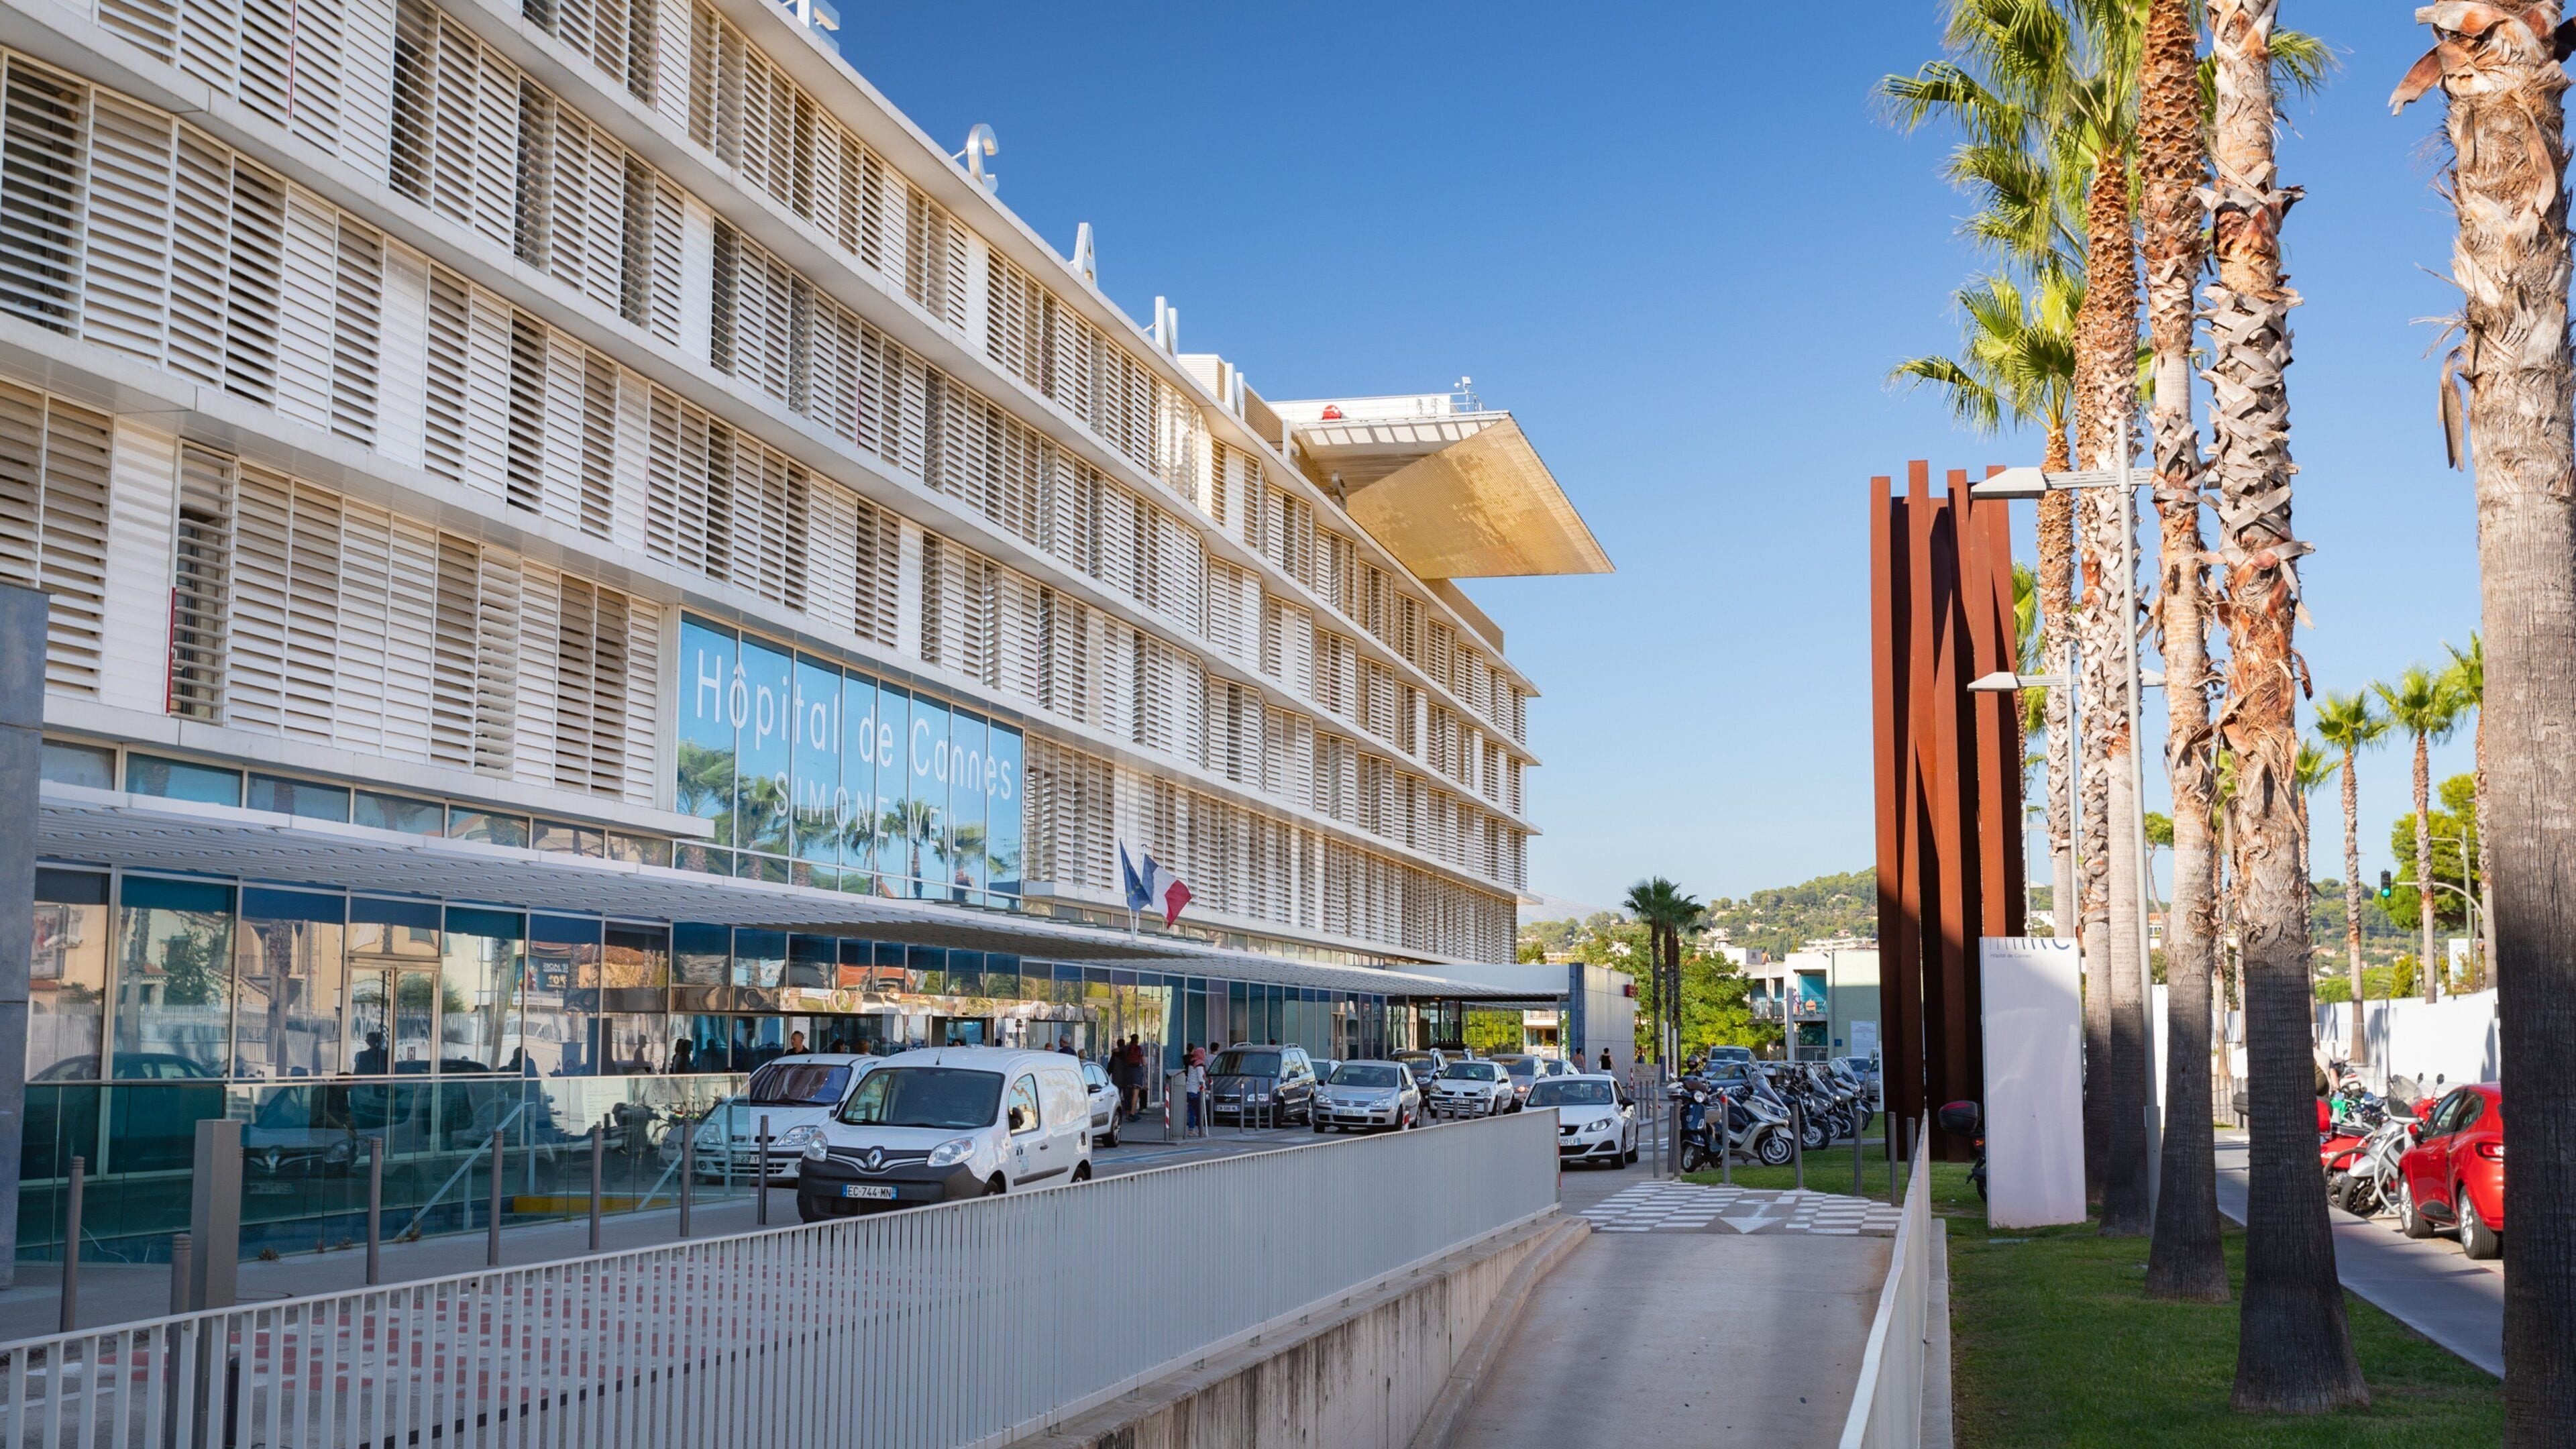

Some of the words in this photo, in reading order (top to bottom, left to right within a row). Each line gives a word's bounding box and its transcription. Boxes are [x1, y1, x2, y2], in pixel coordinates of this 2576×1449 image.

[697, 649, 839, 754] Hôpital
[859, 704, 894, 767] de
[912, 718, 1012, 800] Cannes
[774, 771, 889, 839] SIMONE
[910, 803, 962, 853] VEIL
